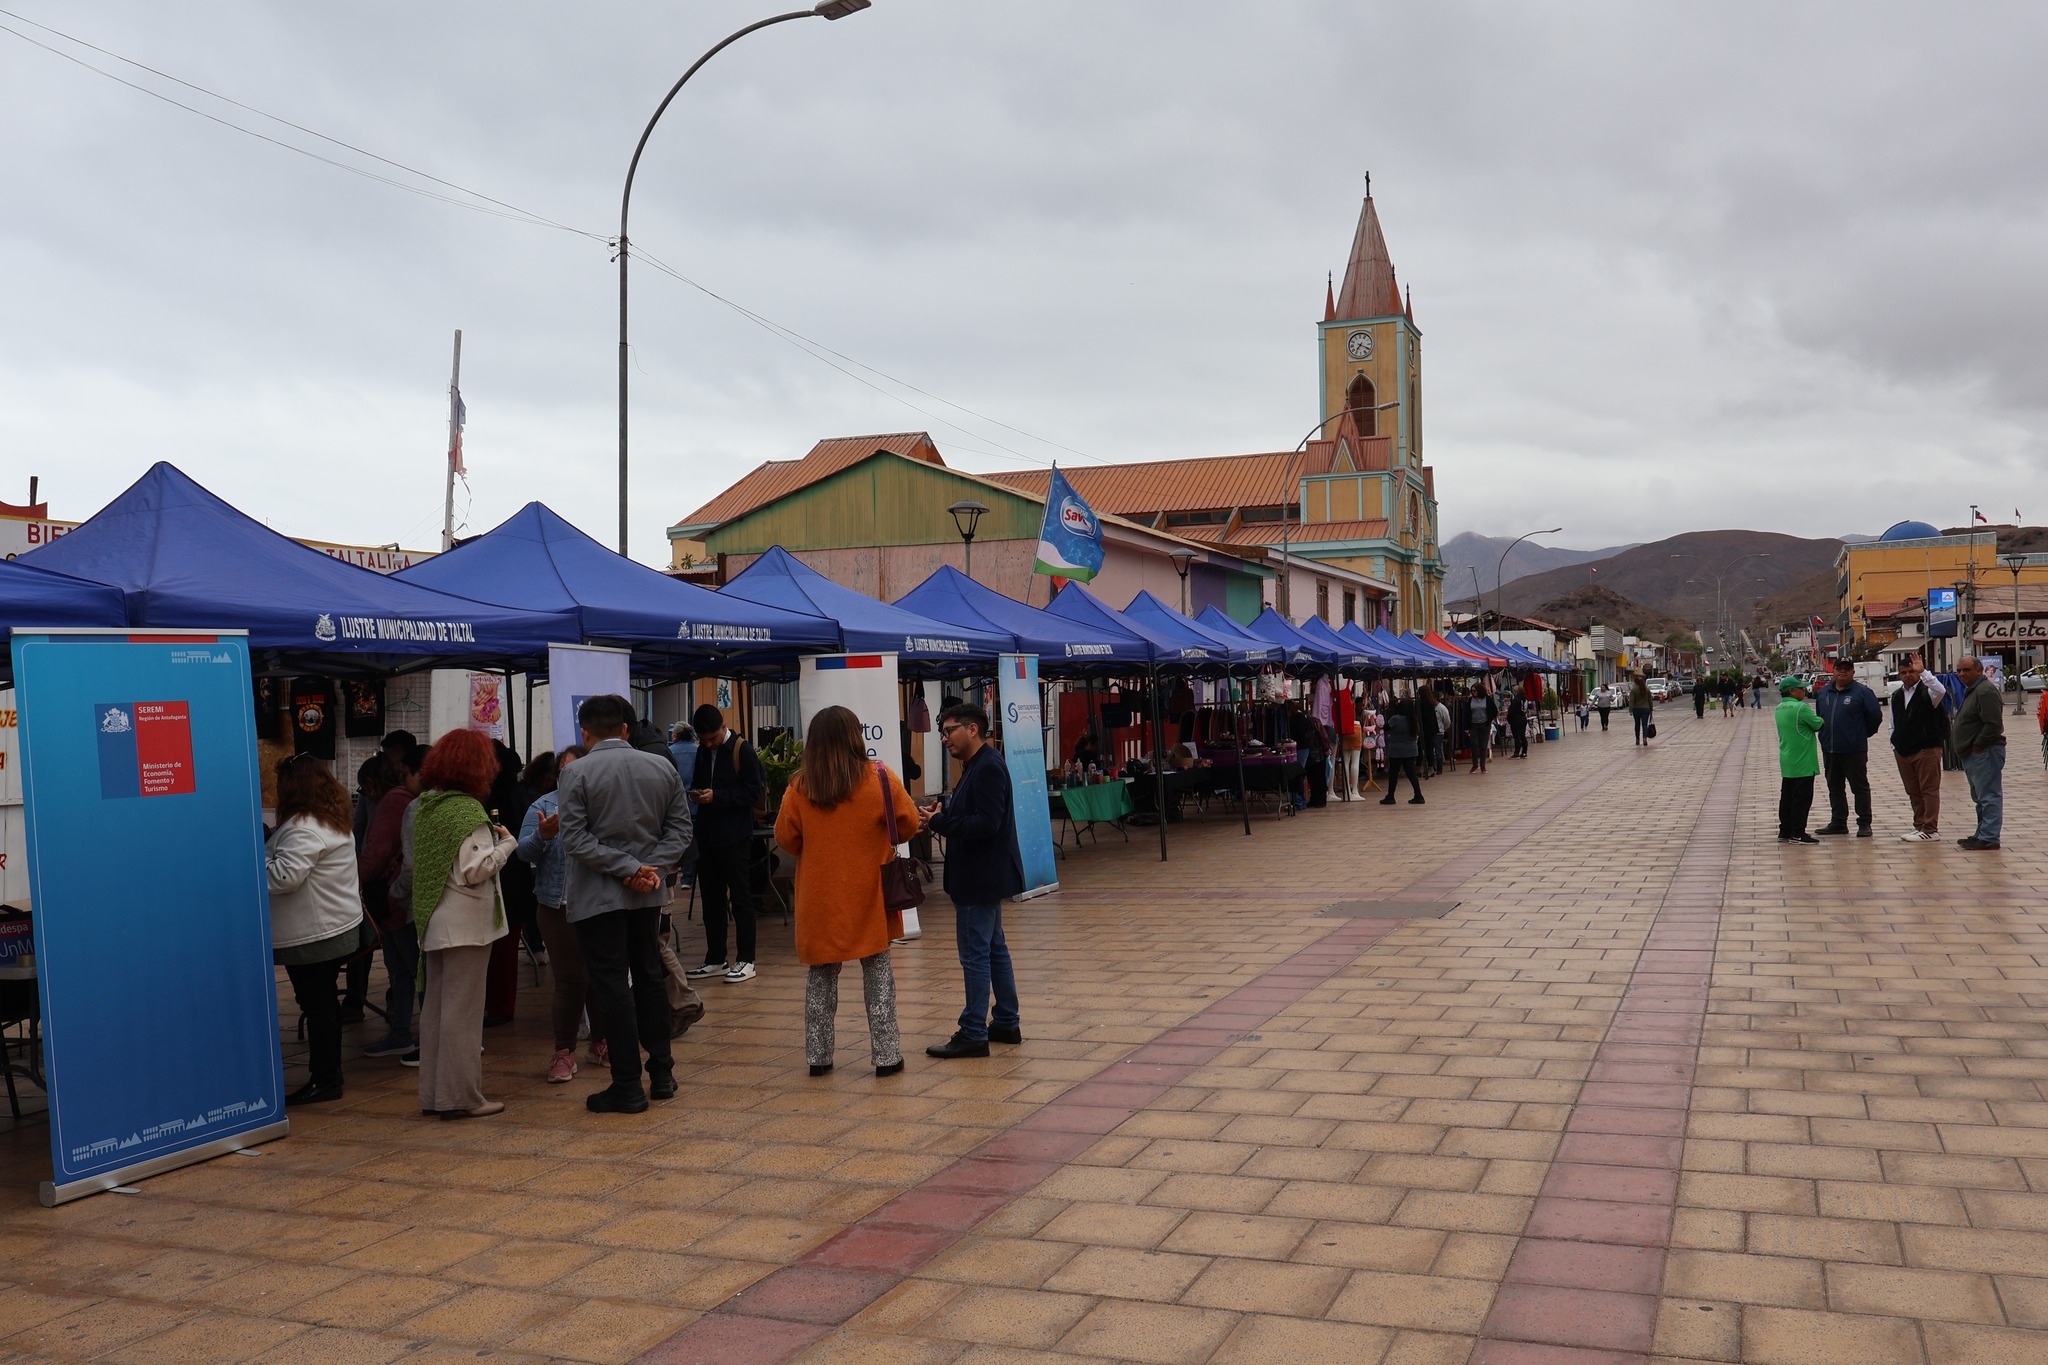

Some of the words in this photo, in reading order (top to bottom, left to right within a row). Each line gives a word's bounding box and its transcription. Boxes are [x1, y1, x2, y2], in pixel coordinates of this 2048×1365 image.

[340, 617, 376, 639] ILUSTRE
[376, 618, 437, 641] MUNICIPALIDAD
[436, 622, 449, 641] DE
[448, 622, 476, 642] TALTAL
[692, 623, 712, 639] ILUSTRE
[138, 706, 164, 714] SEREMI
[143, 762, 173, 770] Ministerio
[143, 769, 174, 778] Economía,
[144, 777, 170, 785] Fomento
[145, 785, 169, 793] Turismo
